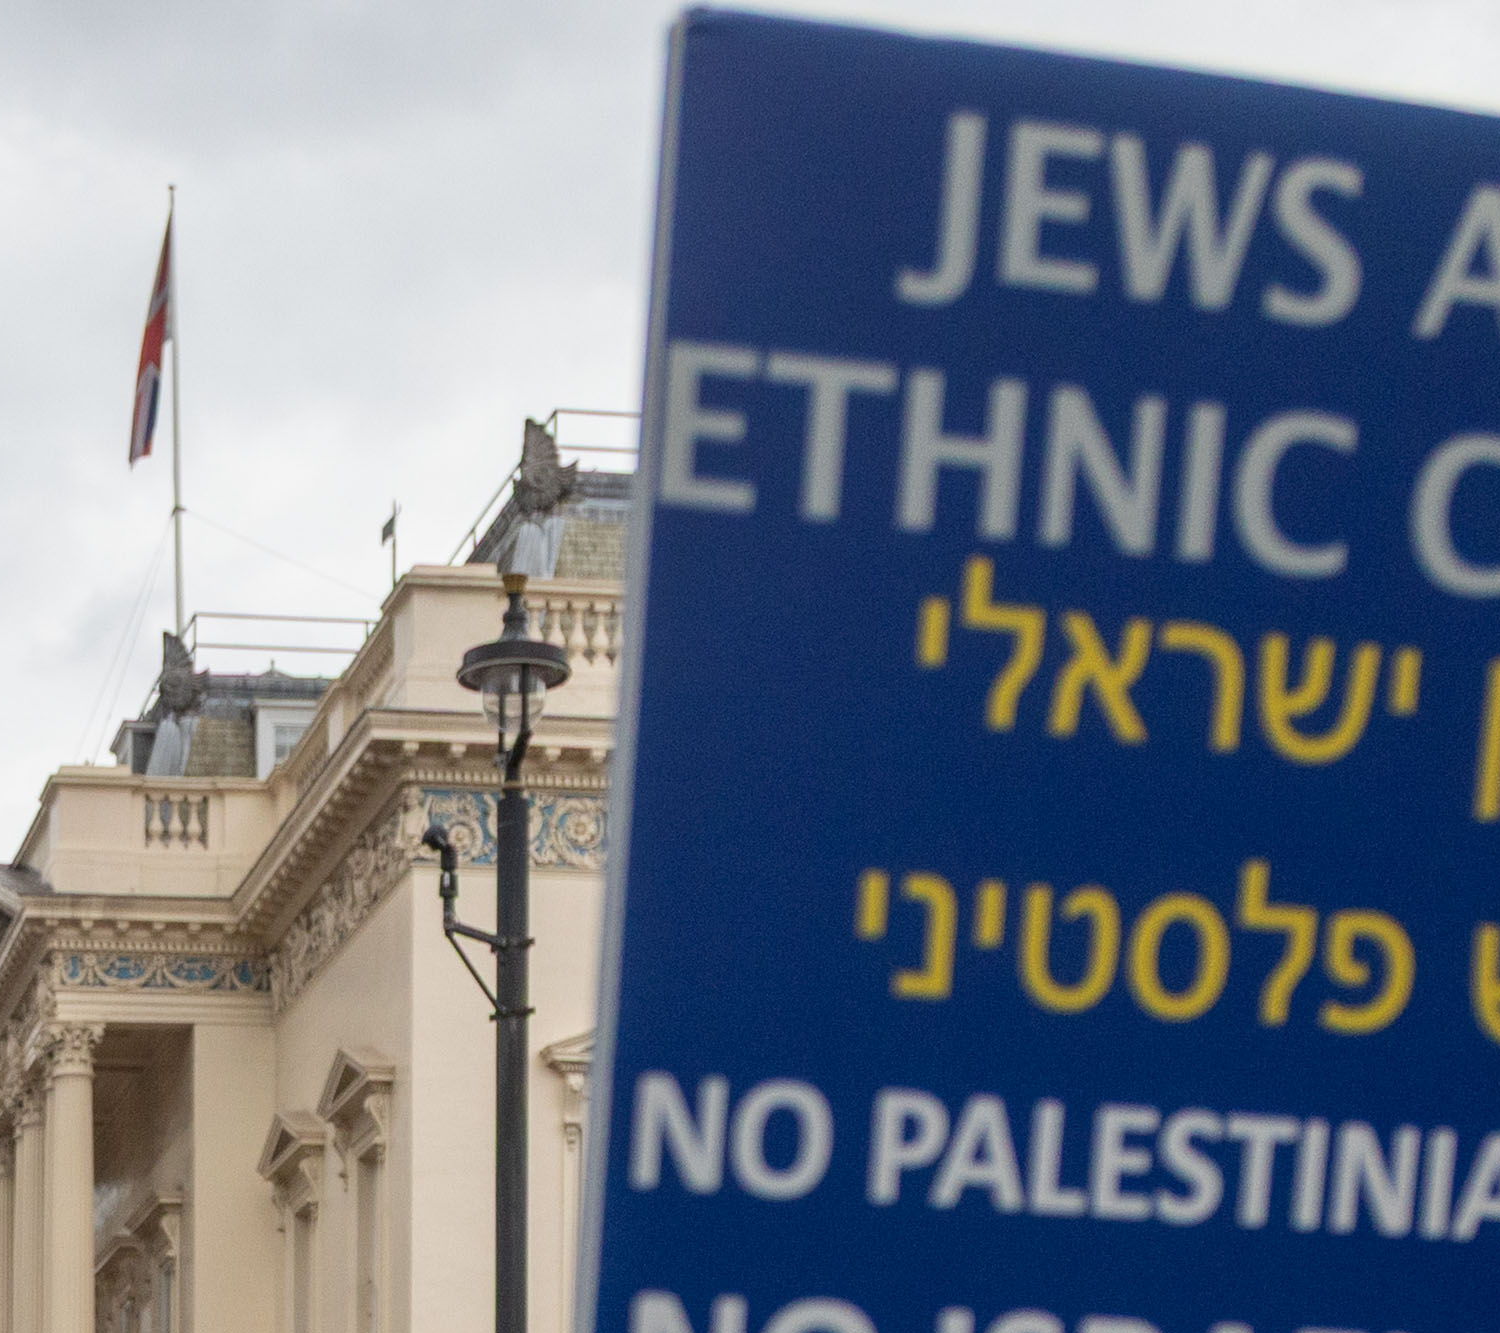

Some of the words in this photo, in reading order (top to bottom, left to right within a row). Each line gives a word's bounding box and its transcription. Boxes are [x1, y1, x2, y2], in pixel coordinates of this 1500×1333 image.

[898, 107, 1363, 330] JEWS
[661, 340, 1359, 577] ETHNIC
[919, 557, 1423, 766] ישראלי
[857, 861, 1419, 1036] פלסטיני
[628, 1071, 835, 1206] NO
